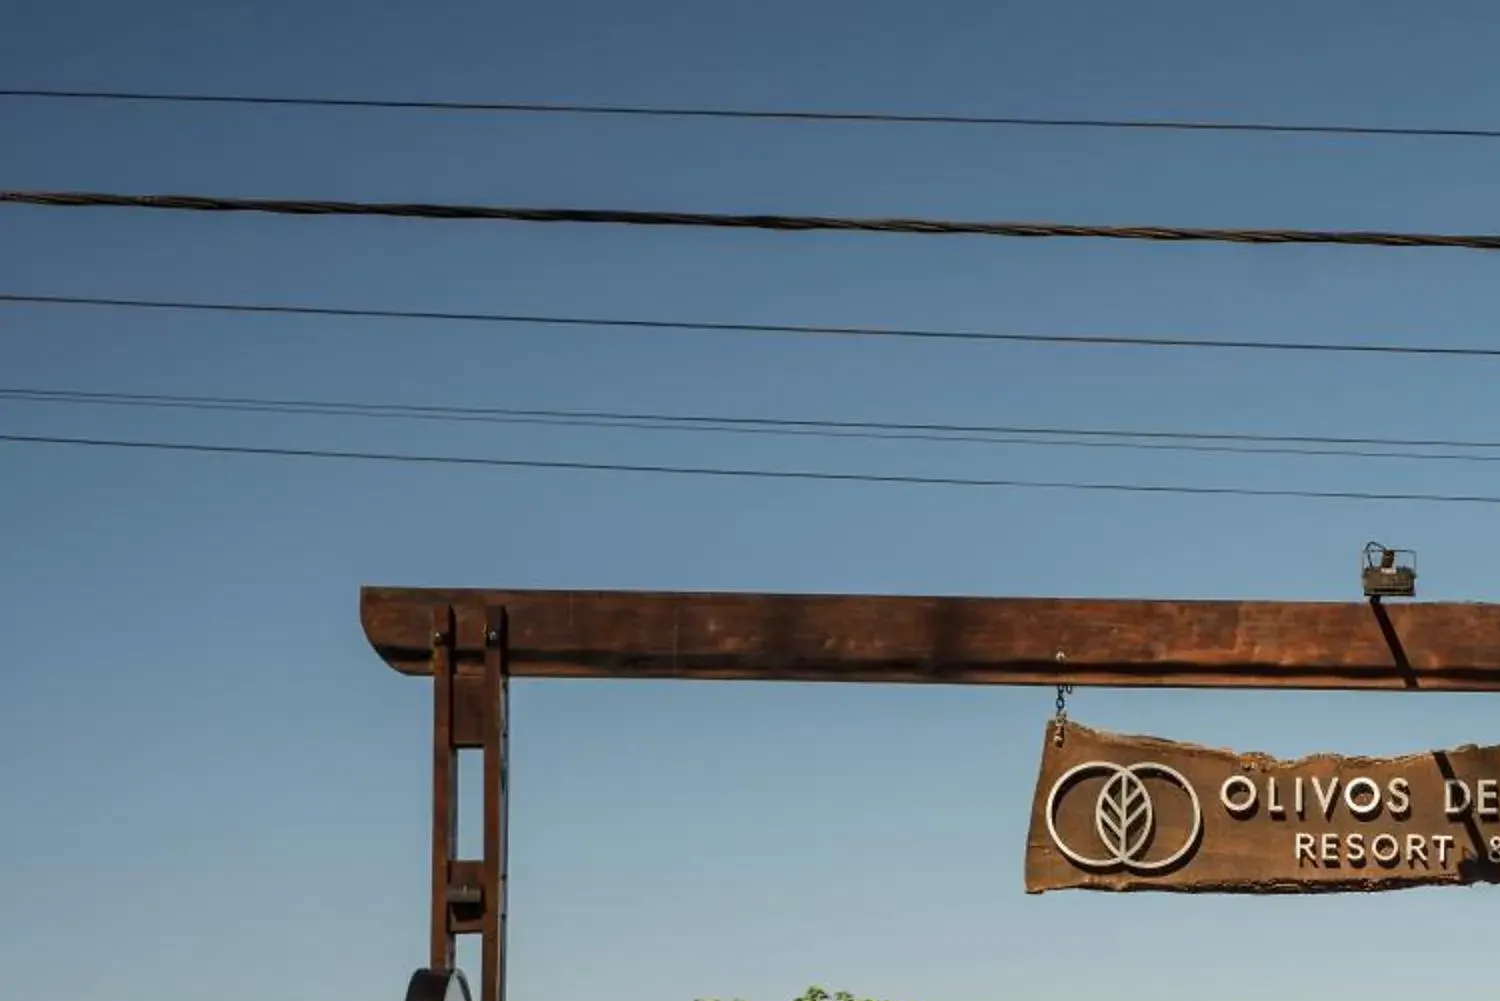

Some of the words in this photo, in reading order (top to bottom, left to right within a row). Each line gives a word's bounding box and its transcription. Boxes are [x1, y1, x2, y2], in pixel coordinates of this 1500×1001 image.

[1220, 775, 1410, 816] OLIVOS
[1444, 779, 1499, 816] DE
[1294, 833, 1453, 863] RESORT
